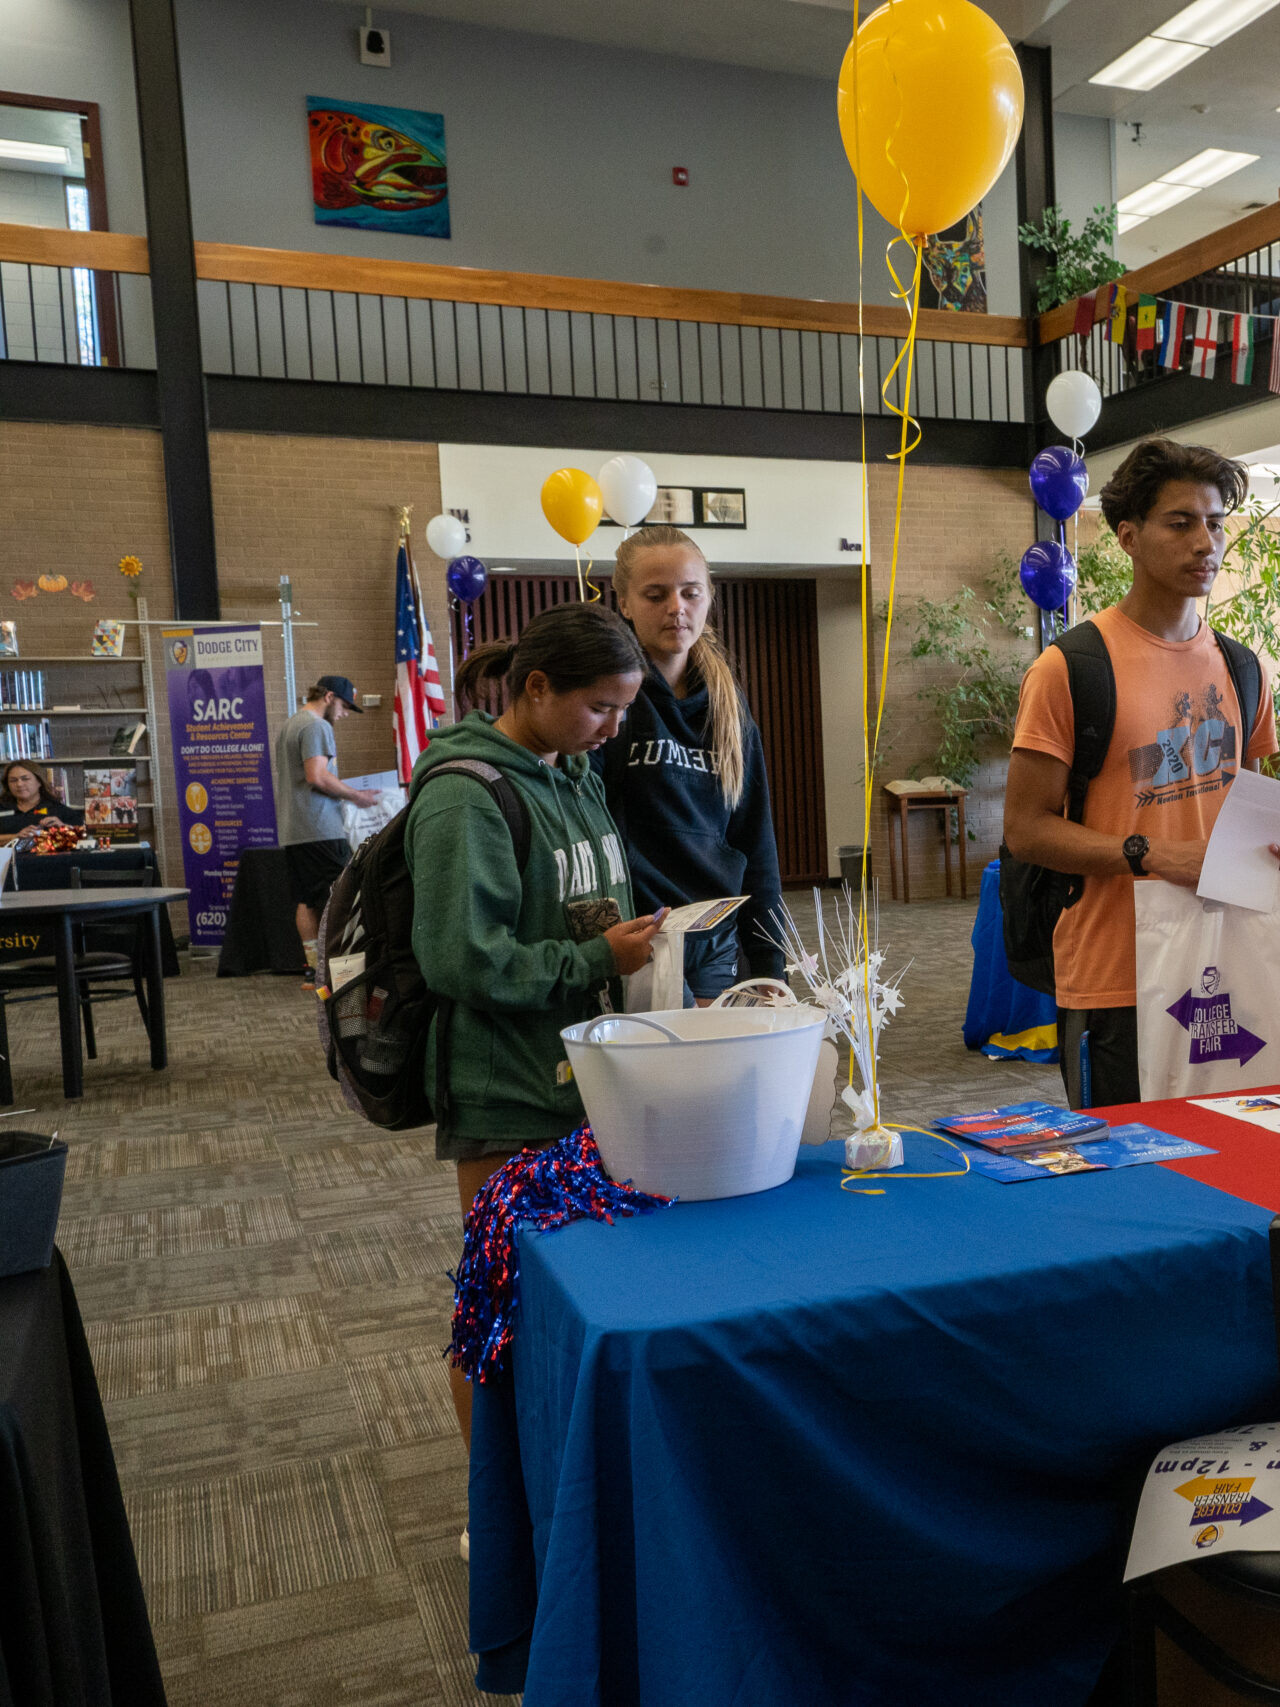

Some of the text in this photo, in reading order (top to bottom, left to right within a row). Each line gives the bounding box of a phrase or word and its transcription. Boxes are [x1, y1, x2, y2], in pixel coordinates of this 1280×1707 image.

[197, 638, 258, 654] DODGE CITY
[193, 697, 243, 721] SARC
[181, 743, 264, 754] DON'T DO COLLEGE ALONE!
[1152, 718, 1225, 788] XC
[1162, 739, 1184, 774] 2020
[1156, 791, 1184, 805] Newton
[196, 911, 226, 927] (620)
[1194, 1004, 1229, 1023] COLLEGE
[1190, 1019, 1236, 1039] TRANSFER
[1200, 1036, 1221, 1054] FAIR
[1155, 1459, 1231, 1475] 12pm
[1213, 1482, 1242, 1494] FAIR
[1193, 1492, 1250, 1505] TRANSFER
[1193, 1503, 1241, 1519] COLLEGE
